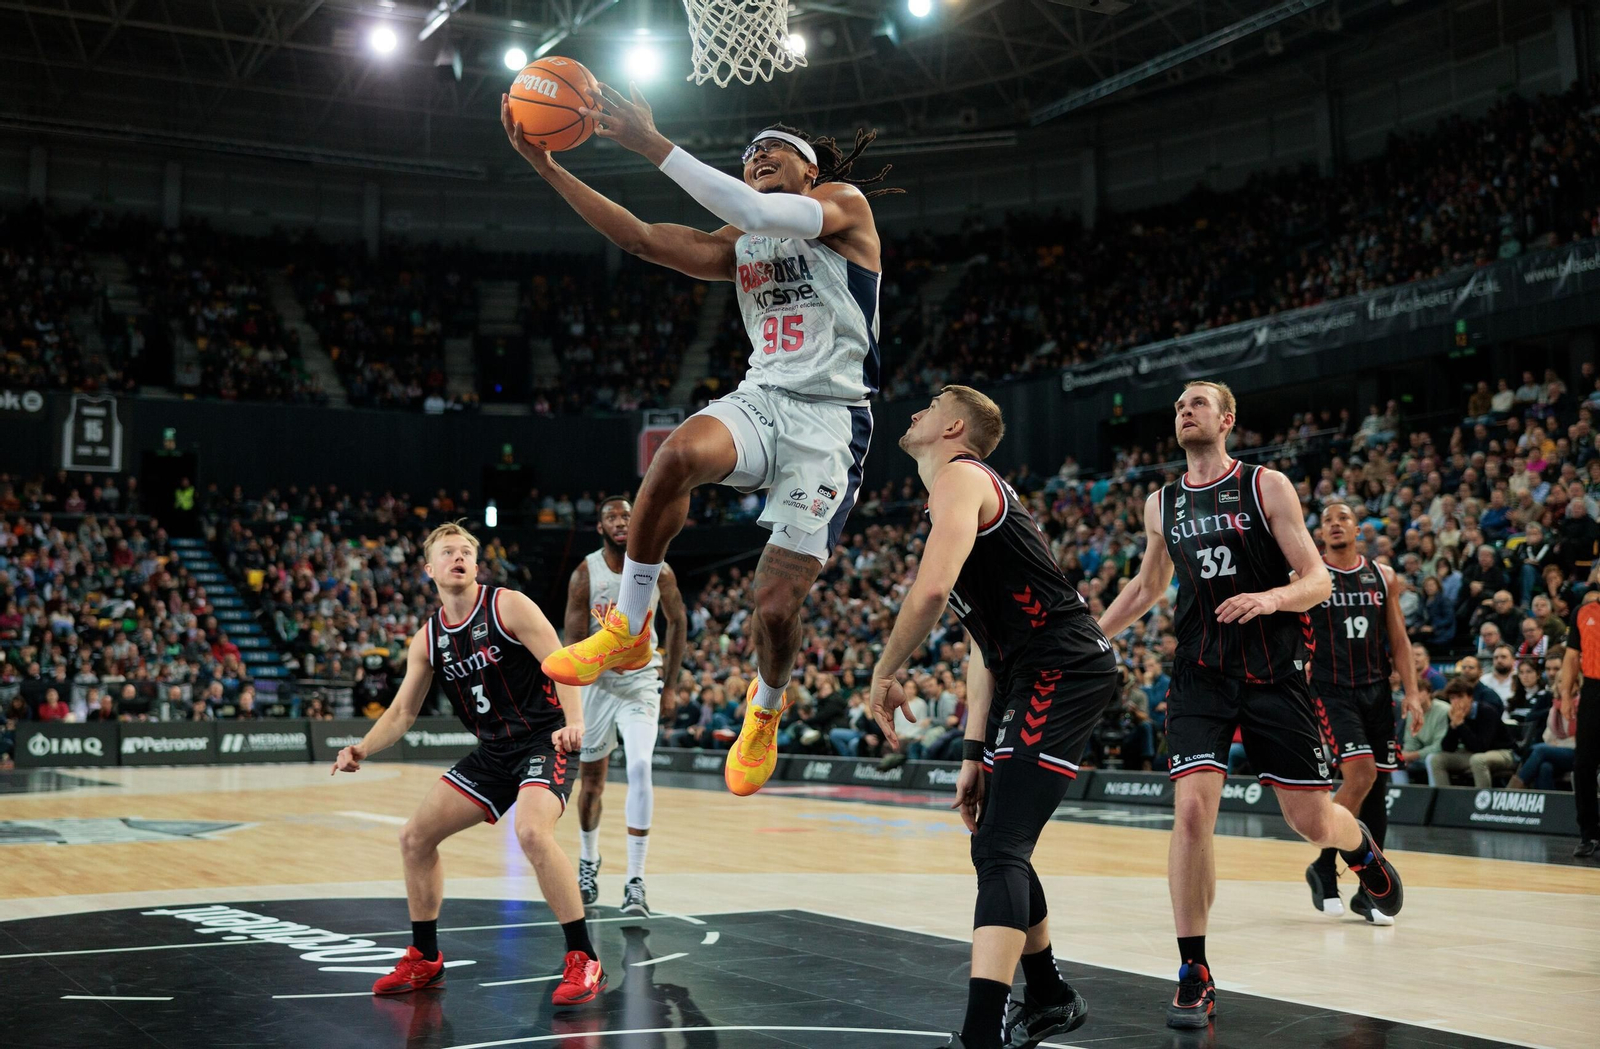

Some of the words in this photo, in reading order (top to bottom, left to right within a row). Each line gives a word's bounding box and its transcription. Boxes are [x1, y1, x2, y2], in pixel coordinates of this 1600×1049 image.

[763, 315, 804, 355] 95
[0, 389, 21, 410] k
[1170, 512, 1251, 545] surne
[1196, 545, 1237, 579] 32
[1320, 590, 1384, 609] surne
[1343, 615, 1369, 638] 19
[443, 644, 503, 682] surne
[470, 684, 491, 714] 3
[50, 736, 104, 756] IMQ
[143, 736, 209, 752] Petronor
[248, 732, 307, 745] MEDRANO
[1104, 782, 1164, 797] NISSAN
[1491, 791, 1546, 814] YAMAHA
